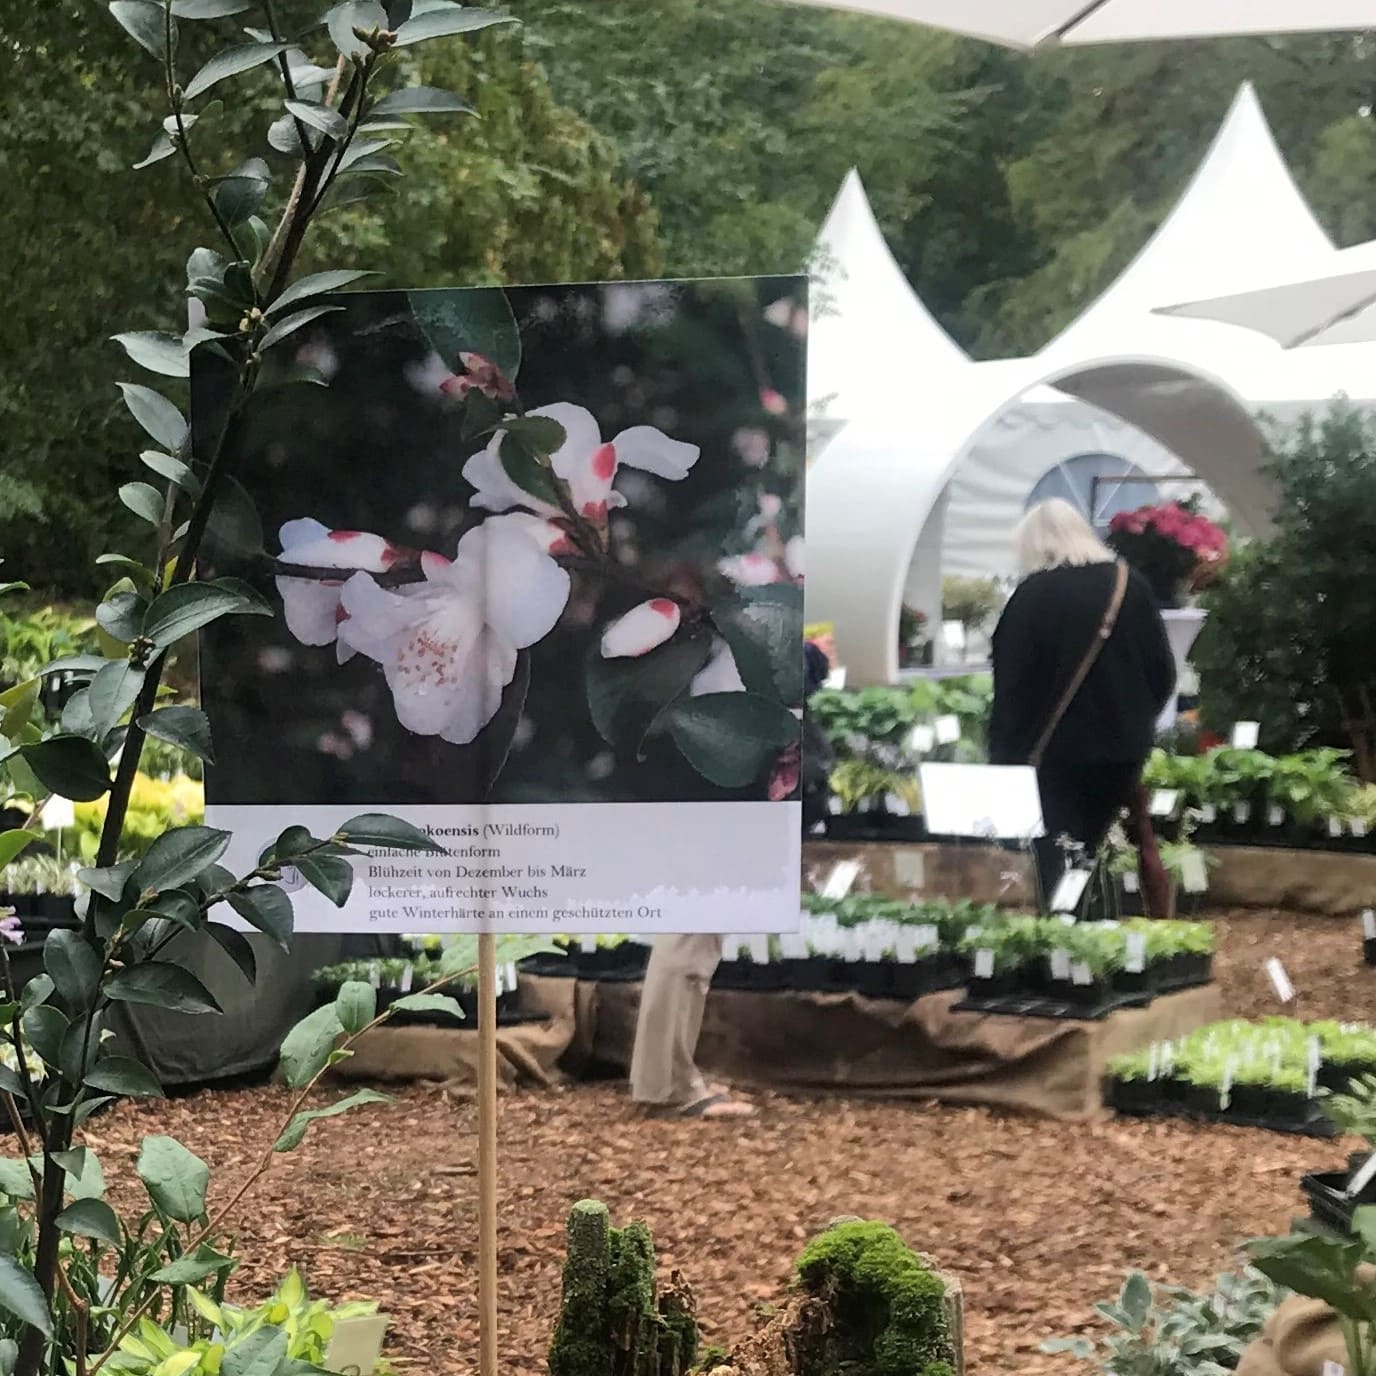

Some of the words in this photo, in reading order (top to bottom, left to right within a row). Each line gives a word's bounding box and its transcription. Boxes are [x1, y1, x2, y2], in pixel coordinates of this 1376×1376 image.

[483, 823, 560, 839] (Wildform)
[368, 864, 423, 878] Blühzeit
[428, 868, 451, 878] von
[456, 864, 523, 878] Dezember
[527, 864, 546, 878] bis
[551, 864, 587, 878] März
[368, 885, 426, 900] lockerer,
[430, 885, 497, 898] aufrechter
[502, 885, 548, 898] Wuchs
[369, 907, 398, 921] gute
[403, 905, 485, 919] Winterhärte
[488, 909, 505, 919] an
[508, 906, 549, 919] einem
[552, 906, 633, 922] geschützten
[637, 905, 663, 919] Ort
